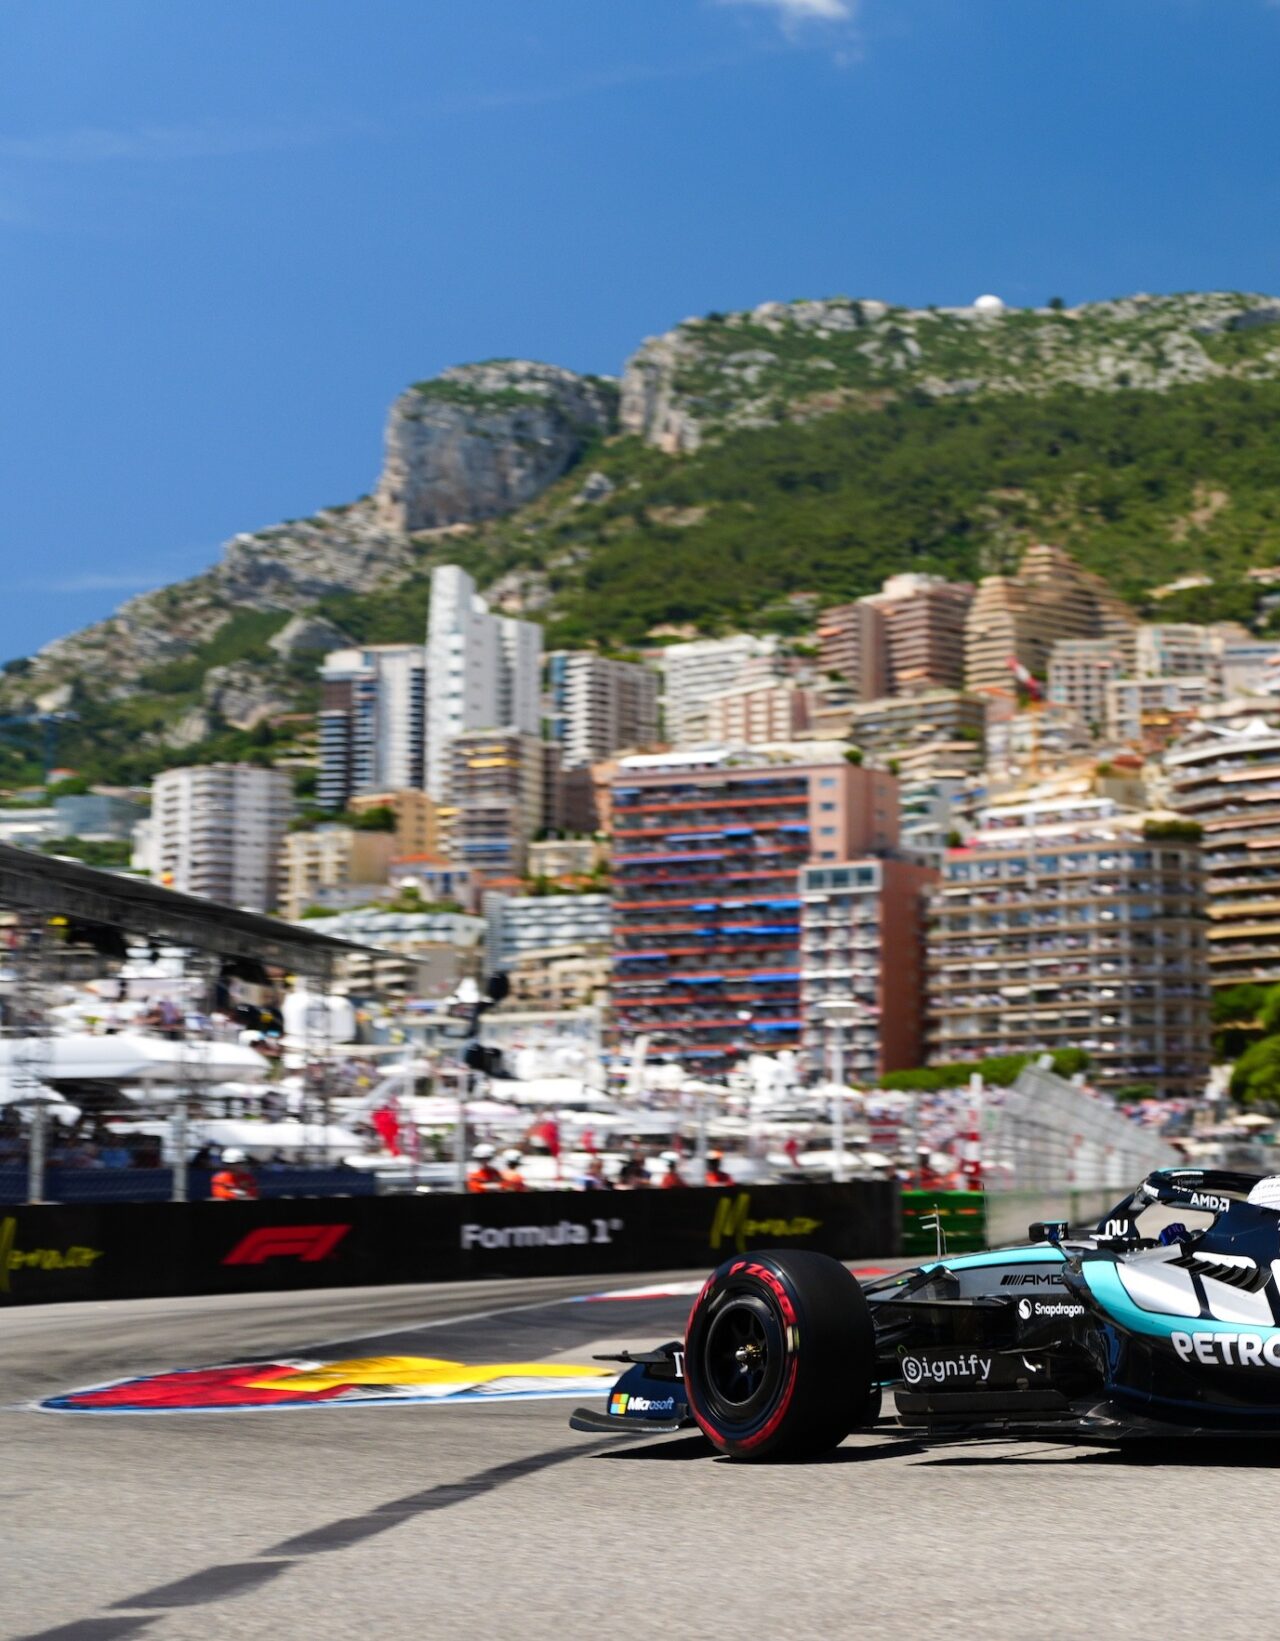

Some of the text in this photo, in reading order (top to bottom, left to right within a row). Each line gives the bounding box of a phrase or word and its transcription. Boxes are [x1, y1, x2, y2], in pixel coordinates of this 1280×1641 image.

[1190, 1192, 1219, 1209] AMD
[461, 1220, 588, 1249] Formula
[1034, 1302, 1085, 1318] Snapdragon
[902, 1354, 991, 1384] signify
[627, 1396, 675, 1411] Microsoft
